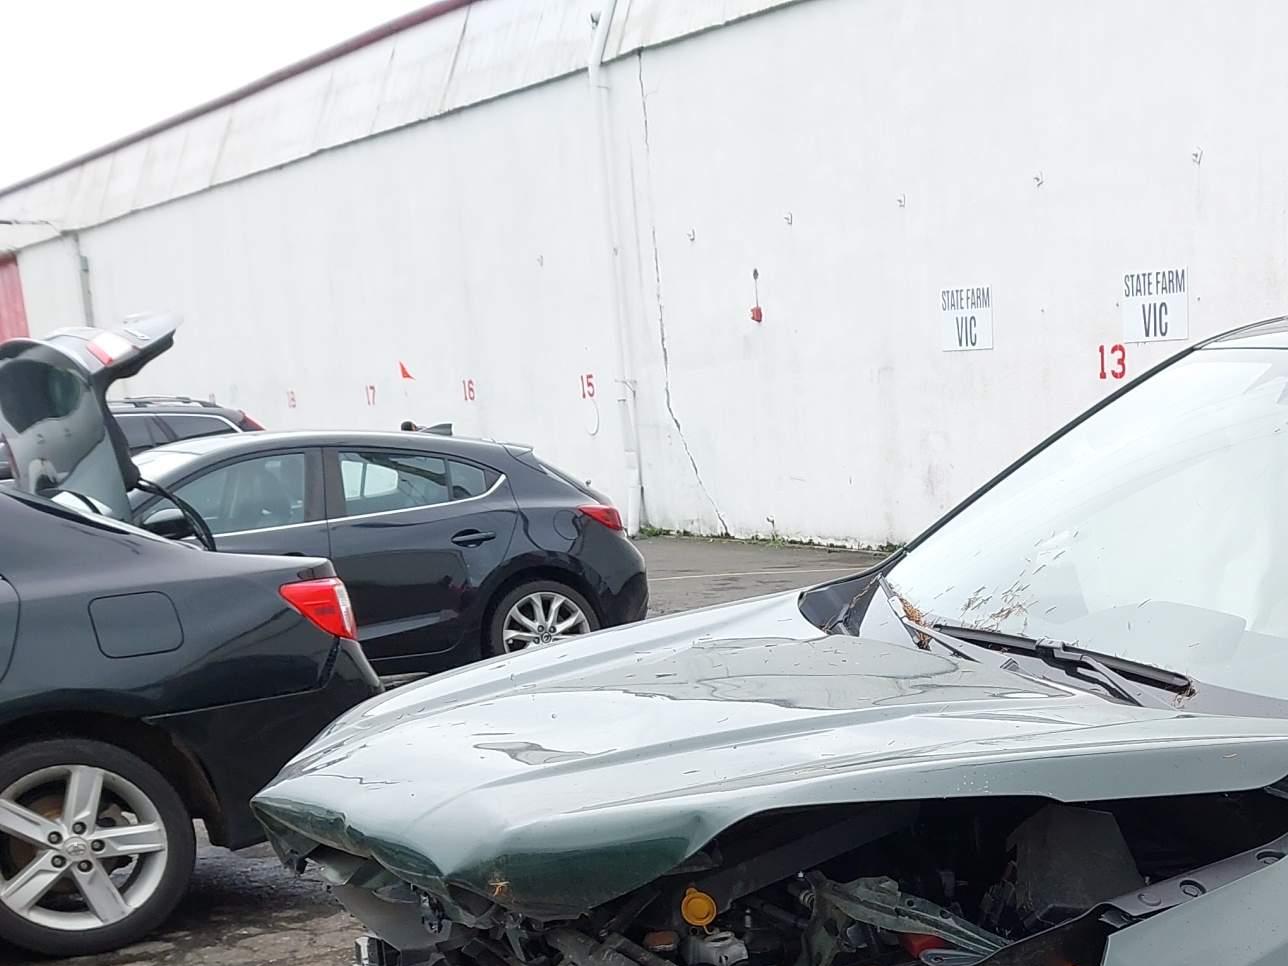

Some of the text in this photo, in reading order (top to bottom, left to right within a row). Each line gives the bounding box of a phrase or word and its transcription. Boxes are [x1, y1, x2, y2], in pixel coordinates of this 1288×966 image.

[1124, 269, 1186, 298] STATE FARM
[941, 287, 991, 312] STATE FARM
[955, 315, 978, 347] VIC
[1142, 301, 1169, 338] VIC
[1098, 344, 1127, 380] 13
[364, 384, 377, 406] 17
[462, 379, 476, 401] 16
[580, 374, 596, 399] 15
